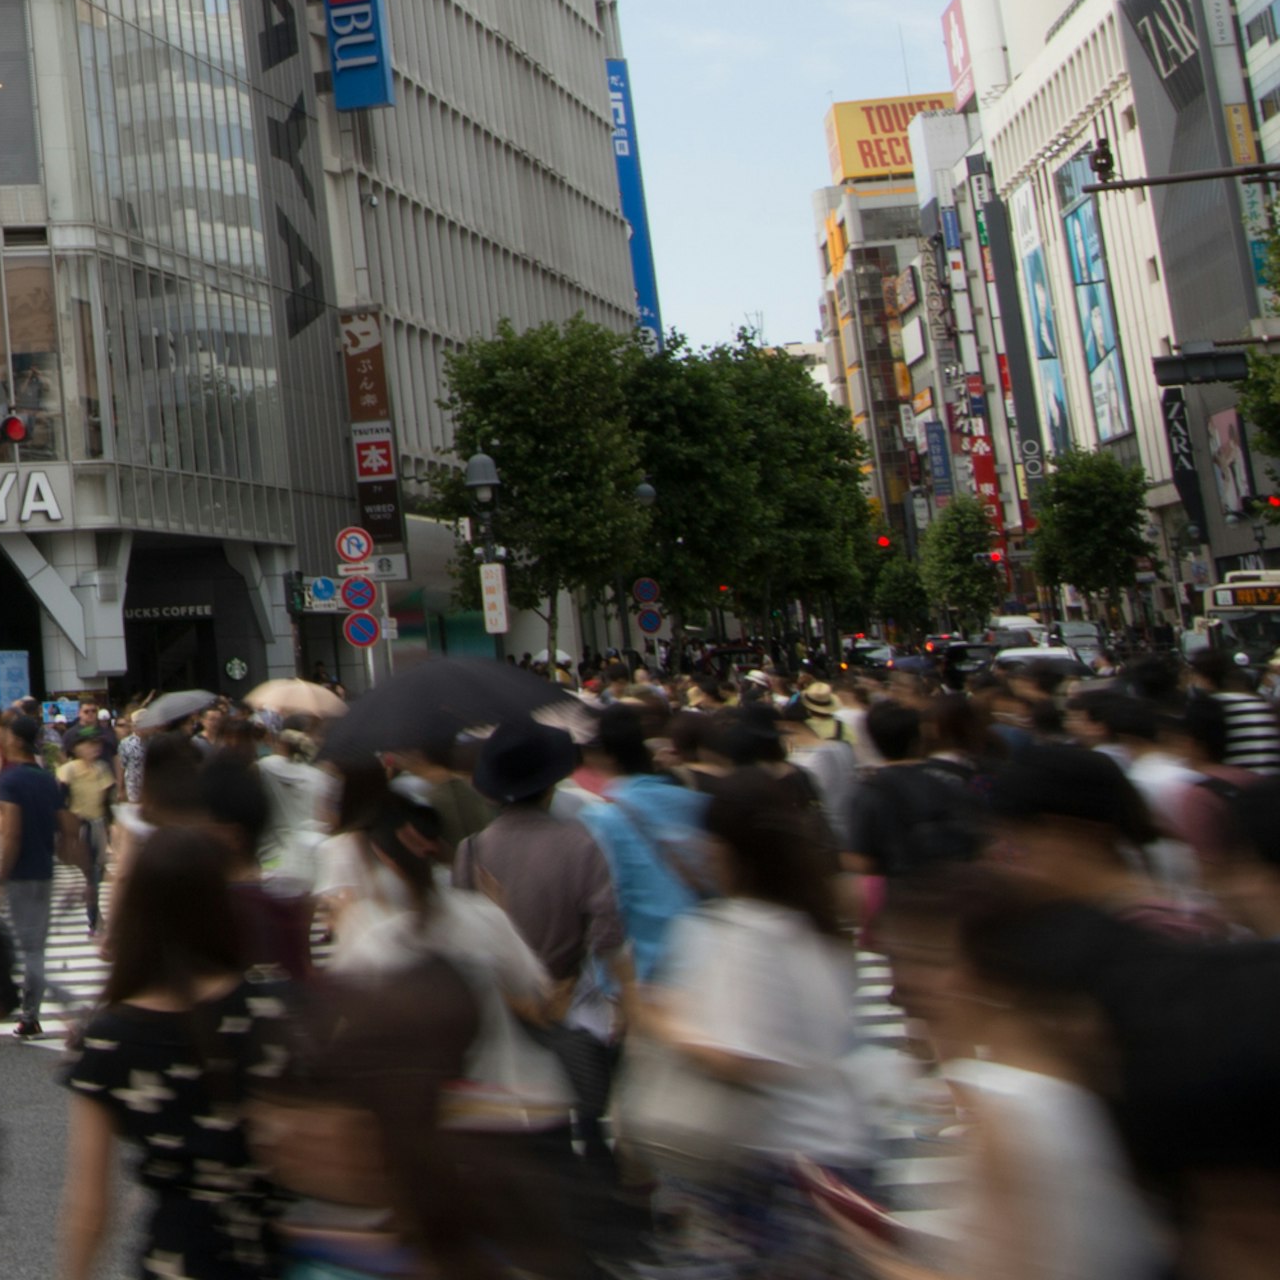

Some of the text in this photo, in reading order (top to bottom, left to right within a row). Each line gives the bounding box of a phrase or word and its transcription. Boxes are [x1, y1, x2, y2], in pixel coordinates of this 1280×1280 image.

[917, 236, 948, 342] KARAOKE
[352, 427, 392, 437] TSUTAYA
[1165, 401, 1195, 471] ZARA
[360, 445, 388, 473] 本
[162, 604, 212, 617] COFFEE
